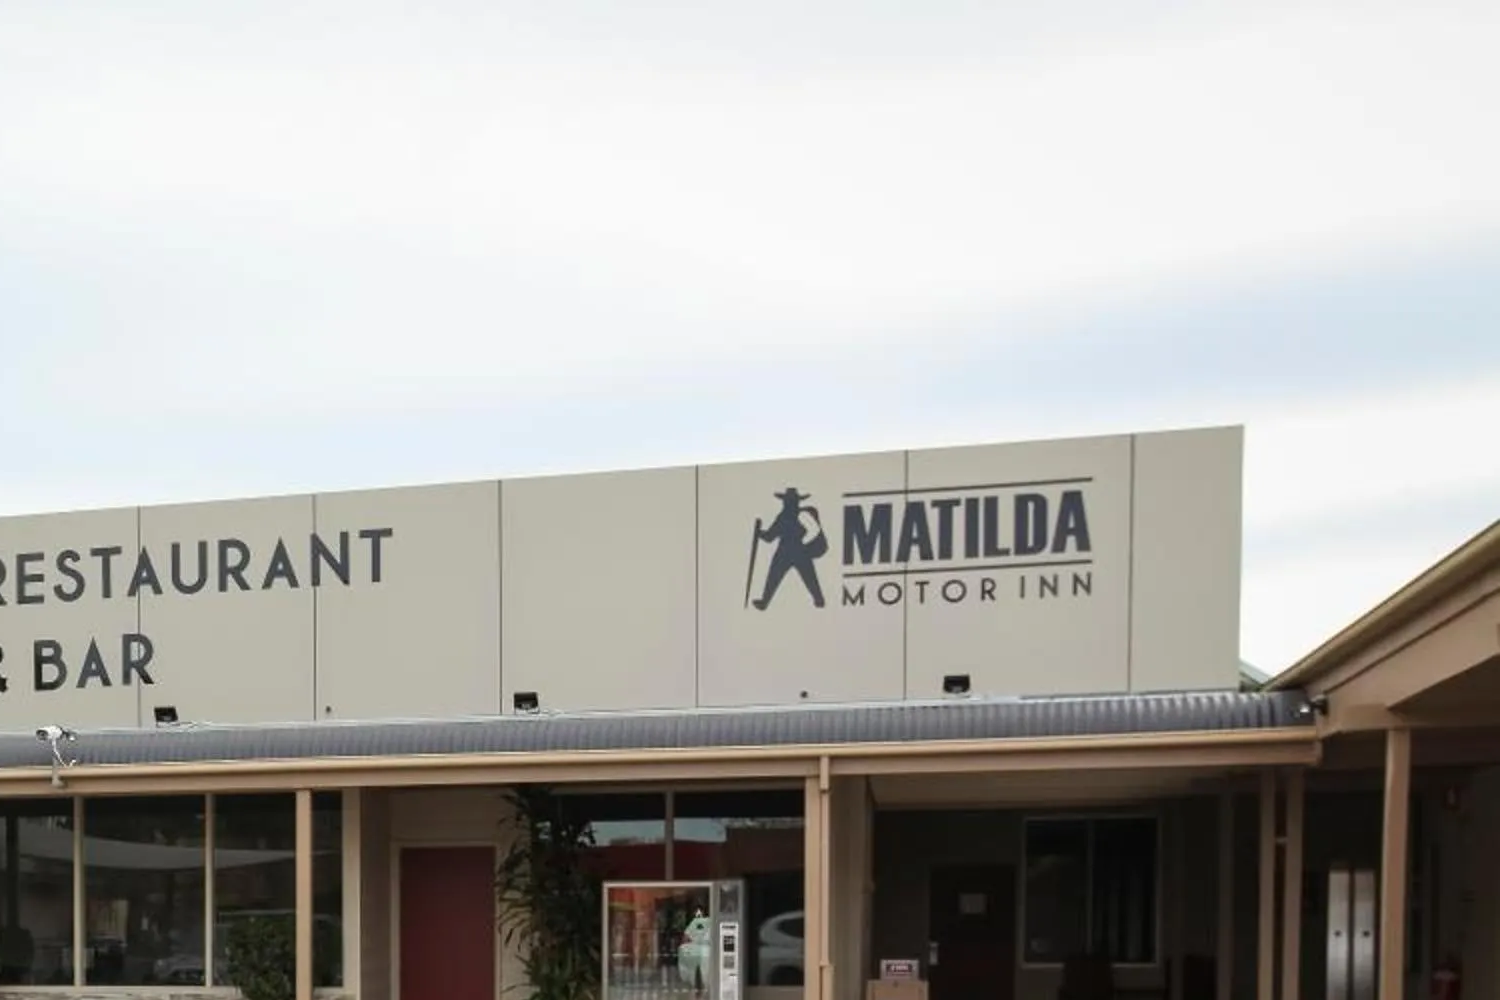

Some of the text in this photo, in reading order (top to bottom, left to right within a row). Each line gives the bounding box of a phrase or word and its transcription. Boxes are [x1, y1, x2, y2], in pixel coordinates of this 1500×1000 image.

[842, 490, 1091, 566] MATILDA
[842, 572, 1092, 606] MOTOR INN
[33, 633, 155, 692] BAR
